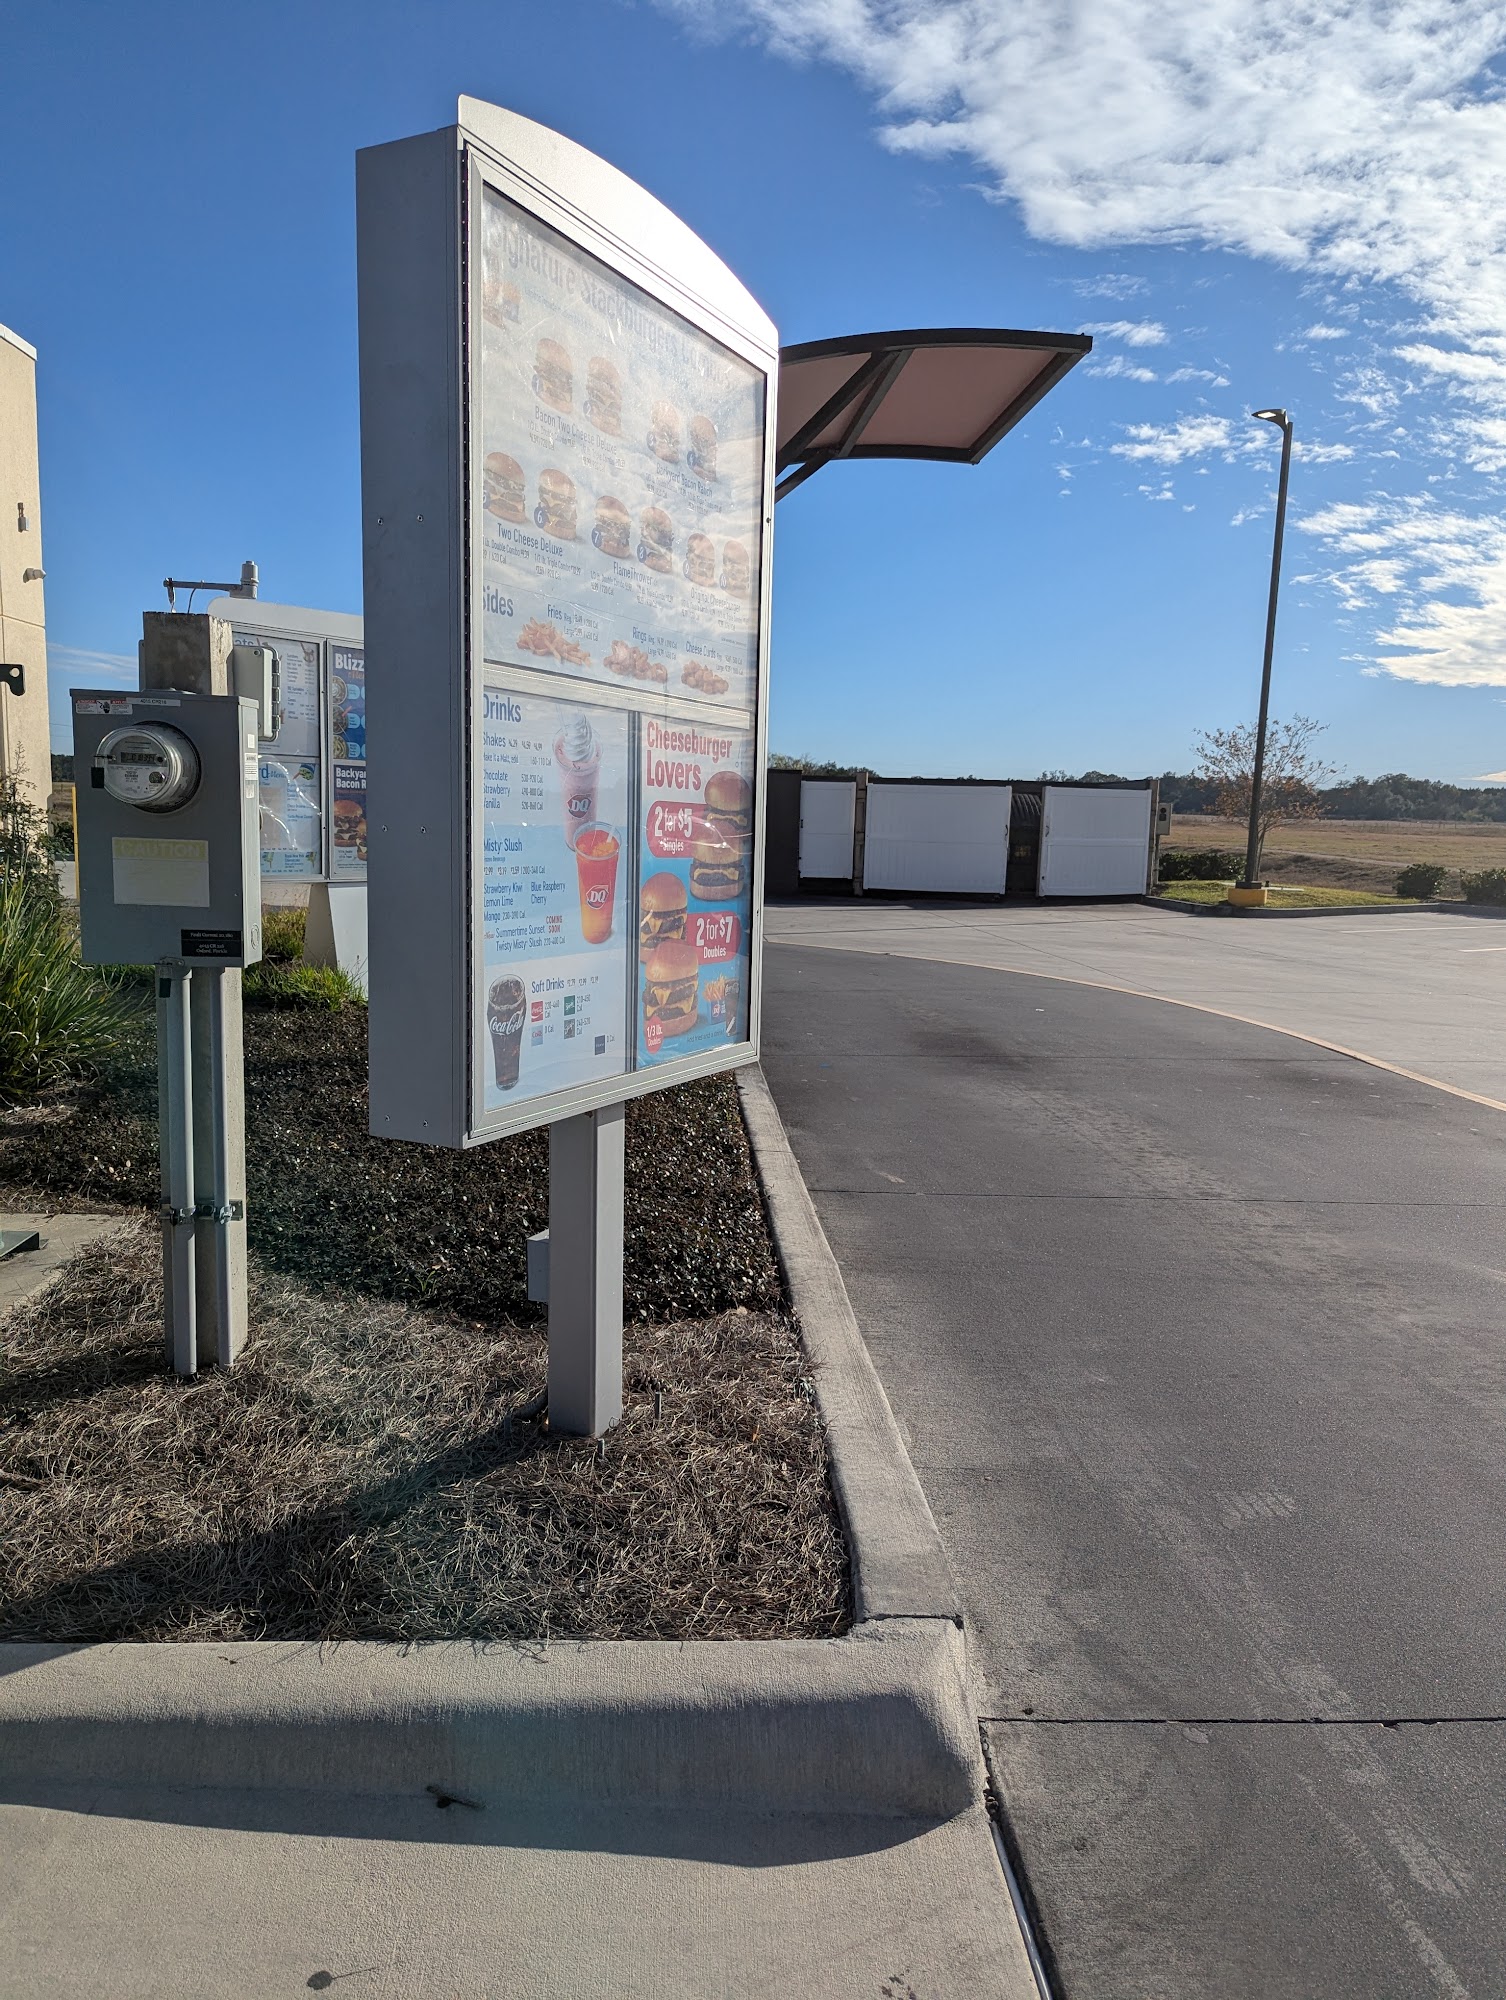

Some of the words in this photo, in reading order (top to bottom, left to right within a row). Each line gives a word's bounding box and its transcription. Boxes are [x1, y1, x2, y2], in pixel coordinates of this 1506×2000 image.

[586, 403, 591, 418] 2
[535, 406, 556, 428] Bacon
[557, 416, 571, 435] Two
[572, 424, 595, 445] Cheese
[597, 435, 617, 456] Deluxe
[657, 463, 680, 483] Backyard
[681, 474, 697, 491] Bacon
[698, 481, 713, 498] Ranch
[497, 523, 512, 541] Two
[514, 529, 539, 549] Cheese
[541, 537, 563, 557] Deluxe
[593, 530, 599, 544] 7
[492, 540, 506, 552] Double
[640, 547, 644, 559] 8
[613, 561, 653, 586] FlameThrower
[685, 563, 689, 574] 9
[547, 604, 563, 620] Fries
[632, 626, 647, 644] Rings
[686, 641, 702, 656] Cheese
[335, 653, 364, 672] Blizz
[484, 693, 521, 723] Drinks
[647, 720, 733, 763] Cheeseburger
[646, 750, 701, 791] Lovers
[336, 778, 360, 789] Bacon
[571, 799, 589, 812] DQ
[654, 806, 663, 837] 2
[664, 808, 677, 832] for
[678, 808, 693, 838] $5
[121, 843, 200, 857] CAUTION
[484, 838, 501, 854] Misty
[504, 838, 523, 852] Slush
[662, 838, 684, 854] Singles
[484, 883, 511, 895] Strawberry
[512, 882, 523, 893] Kiwi
[531, 881, 542, 892] Blue
[543, 880, 566, 894] Raspberry
[484, 897, 501, 908] Lemon
[501, 896, 514, 906] Lime
[531, 894, 547, 905] Cherry
[590, 890, 606, 903] DQ
[484, 911, 501, 923] Mango
[546, 915, 563, 924] COMING
[496, 926, 528, 938] Summertime
[529, 925, 546, 935] Sunset
[548, 925, 561, 934] SOON
[696, 917, 704, 946] 2
[706, 918, 718, 941] for
[719, 916, 733, 944] $7
[496, 941, 512, 952] Twisty
[513, 939, 527, 950] Misty
[529, 937, 543, 948] Slush
[703, 946, 727, 959] Doubles
[531, 981, 545, 994] Soft
[546, 978, 565, 991] Drinks
[646, 1025, 656, 1038] 1/3
[648, 1038, 662, 1047] Doubles
